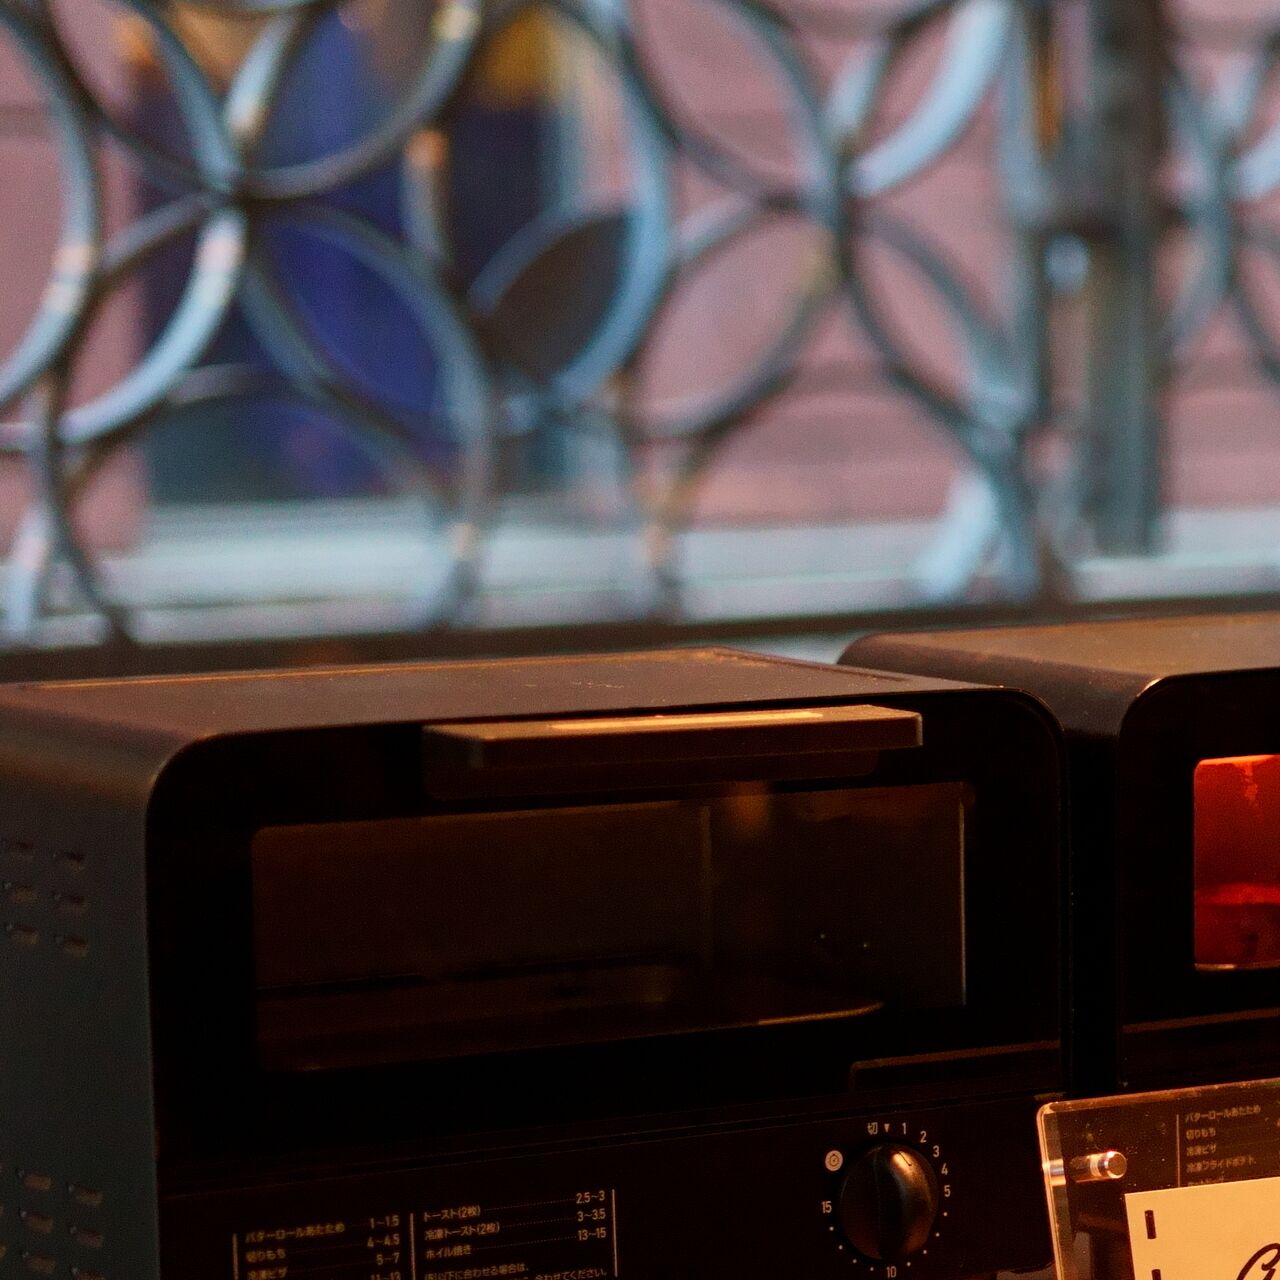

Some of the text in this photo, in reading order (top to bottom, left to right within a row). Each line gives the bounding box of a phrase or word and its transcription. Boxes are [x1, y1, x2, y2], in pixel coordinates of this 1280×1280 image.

[901, 1122, 907, 1135] 1
[920, 1130, 927, 1143] 2
[933, 1145, 940, 1157] 3
[941, 1162, 949, 1175] 4
[944, 1185, 951, 1197] 5
[821, 1200, 832, 1214] 15
[886, 1266, 897, 1278] 10
